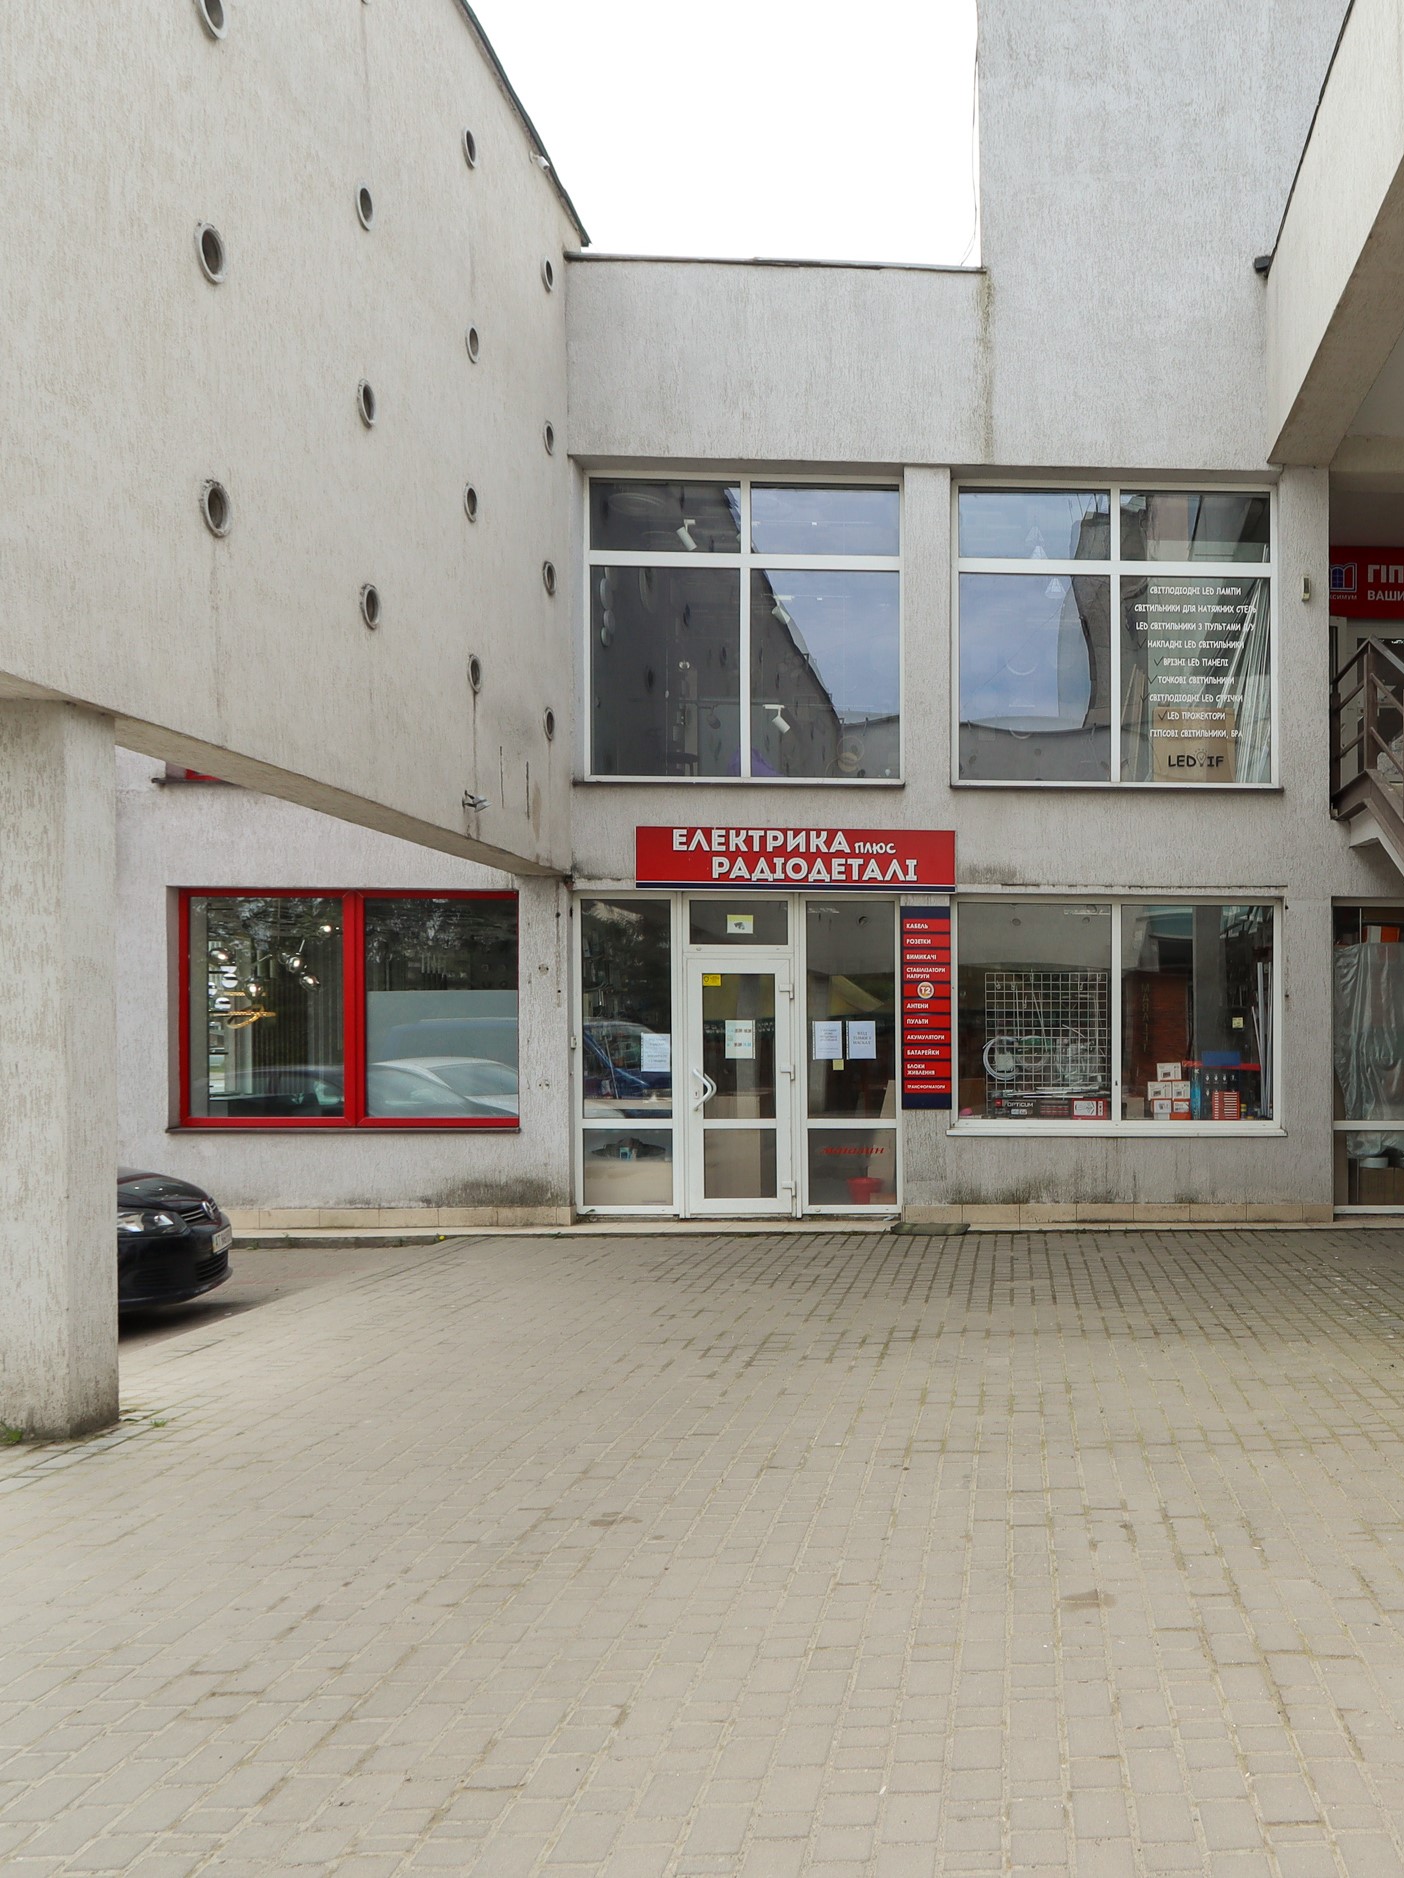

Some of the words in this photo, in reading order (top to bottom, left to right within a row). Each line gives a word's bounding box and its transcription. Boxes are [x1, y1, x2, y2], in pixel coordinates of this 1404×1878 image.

[1149, 586, 1200, 596] СВІТЛОДІОДНІ
[1202, 586, 1214, 595] LED
[1216, 587, 1241, 596] ЛАМПИ
[1134, 603, 1181, 613] СВІТИЛЬНИКИ
[1182, 604, 1196, 614] ДЛЯ
[1197, 604, 1234, 614] НАТЯЖНИХ
[1135, 621, 1148, 630] LED
[1150, 621, 1196, 630] СВІТИЛЬНИКИ
[1204, 622, 1241, 631] ПУЛЬТАМИ
[1147, 639, 1182, 649] НАКЛАДНІ
[1184, 640, 1197, 648] LED
[1198, 640, 1244, 649] СВІТИЛЬНИКИ
[1163, 658, 1186, 666] ВРІЗНІ
[1187, 658, 1200, 667] LED
[1202, 658, 1228, 666] ПАНЕЛІ
[1158, 675, 1186, 684] ТОЧКОВІ
[1188, 676, 1235, 685] СВІТИЛЬНИКИ
[1149, 693, 1200, 703] СВІТЛОДІОДНІ
[1201, 694, 1214, 702] LED
[1167, 711, 1180, 720] LED
[1182, 711, 1226, 720] ПРОЖЕКТОРИ
[1149, 729, 1179, 738] ГІПСОВІ
[1180, 729, 1229, 739] СВІТИЛЬНИКИ,
[1168, 754, 1197, 767] LED
[1207, 755, 1224, 767] IF
[672, 828, 851, 853] ЕЛЕКТРИКА
[712, 856, 918, 882] РАДІОДЕТАЛІ
[906, 1048, 940, 1056] БАТАРЕЙКИ
